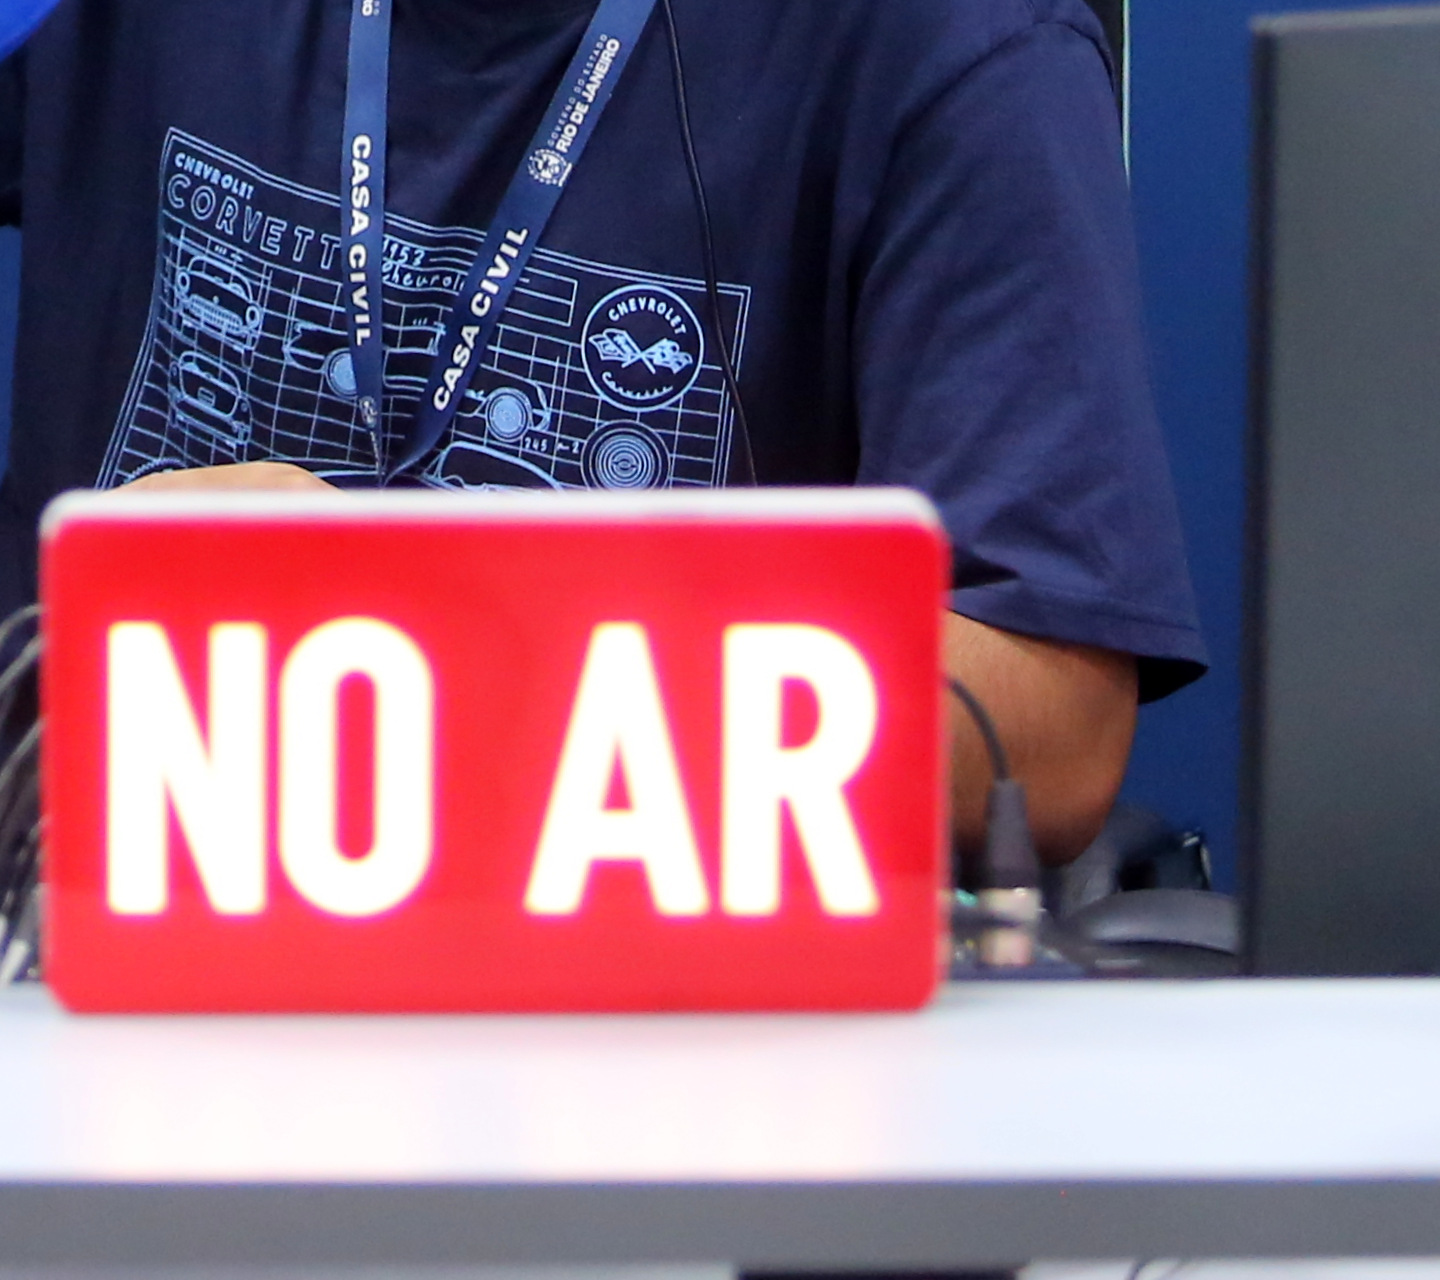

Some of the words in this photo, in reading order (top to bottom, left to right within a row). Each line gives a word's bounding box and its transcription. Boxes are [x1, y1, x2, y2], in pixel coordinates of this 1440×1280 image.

[555, 122, 578, 154] RIO
[569, 101, 590, 126] DE
[581, 38, 621, 104] JANEIRO
[582, 33, 608, 76] ESTADO
[166, 176, 342, 272] CORVETT
[174, 150, 256, 201] CHEVROLET
[350, 133, 373, 237] CASA
[349, 243, 372, 347] CIVIL
[432, 324, 480, 413] CASA
[473, 226, 530, 320] CIVIL
[607, 295, 688, 336] CHEVROLET
[106, 615, 434, 918] NO
[522, 620, 882, 918] AR
